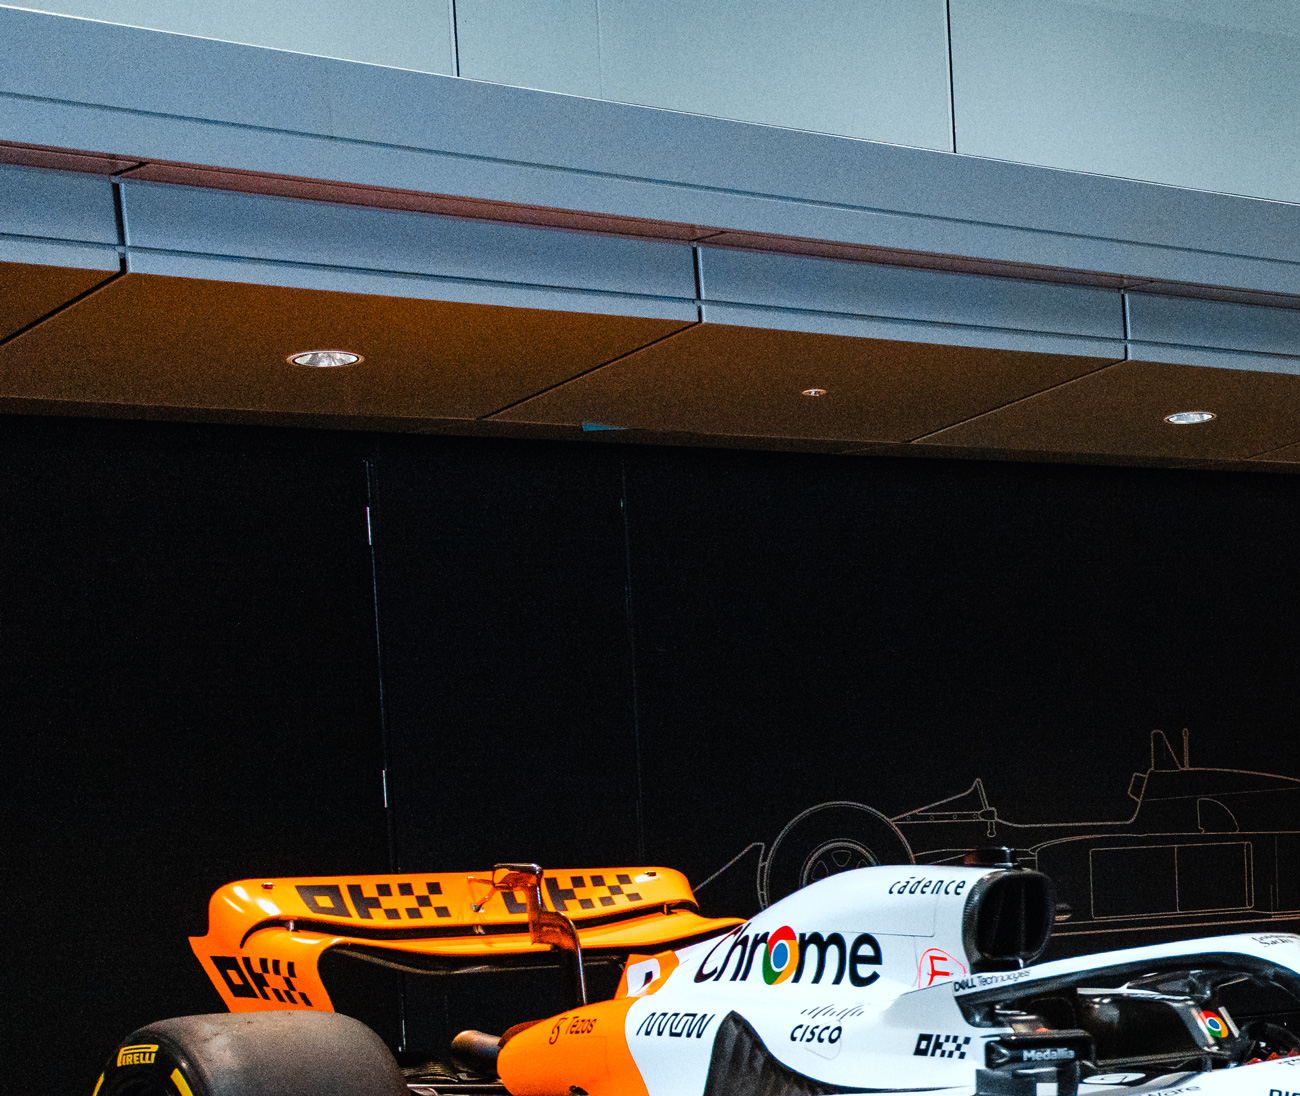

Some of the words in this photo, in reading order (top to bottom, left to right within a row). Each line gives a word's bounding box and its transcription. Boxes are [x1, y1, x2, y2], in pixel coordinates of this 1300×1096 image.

[693, 921, 883, 988] Chrome
[116, 1044, 159, 1068] PIRELLI
[1022, 1047, 1075, 1062] Medallia
